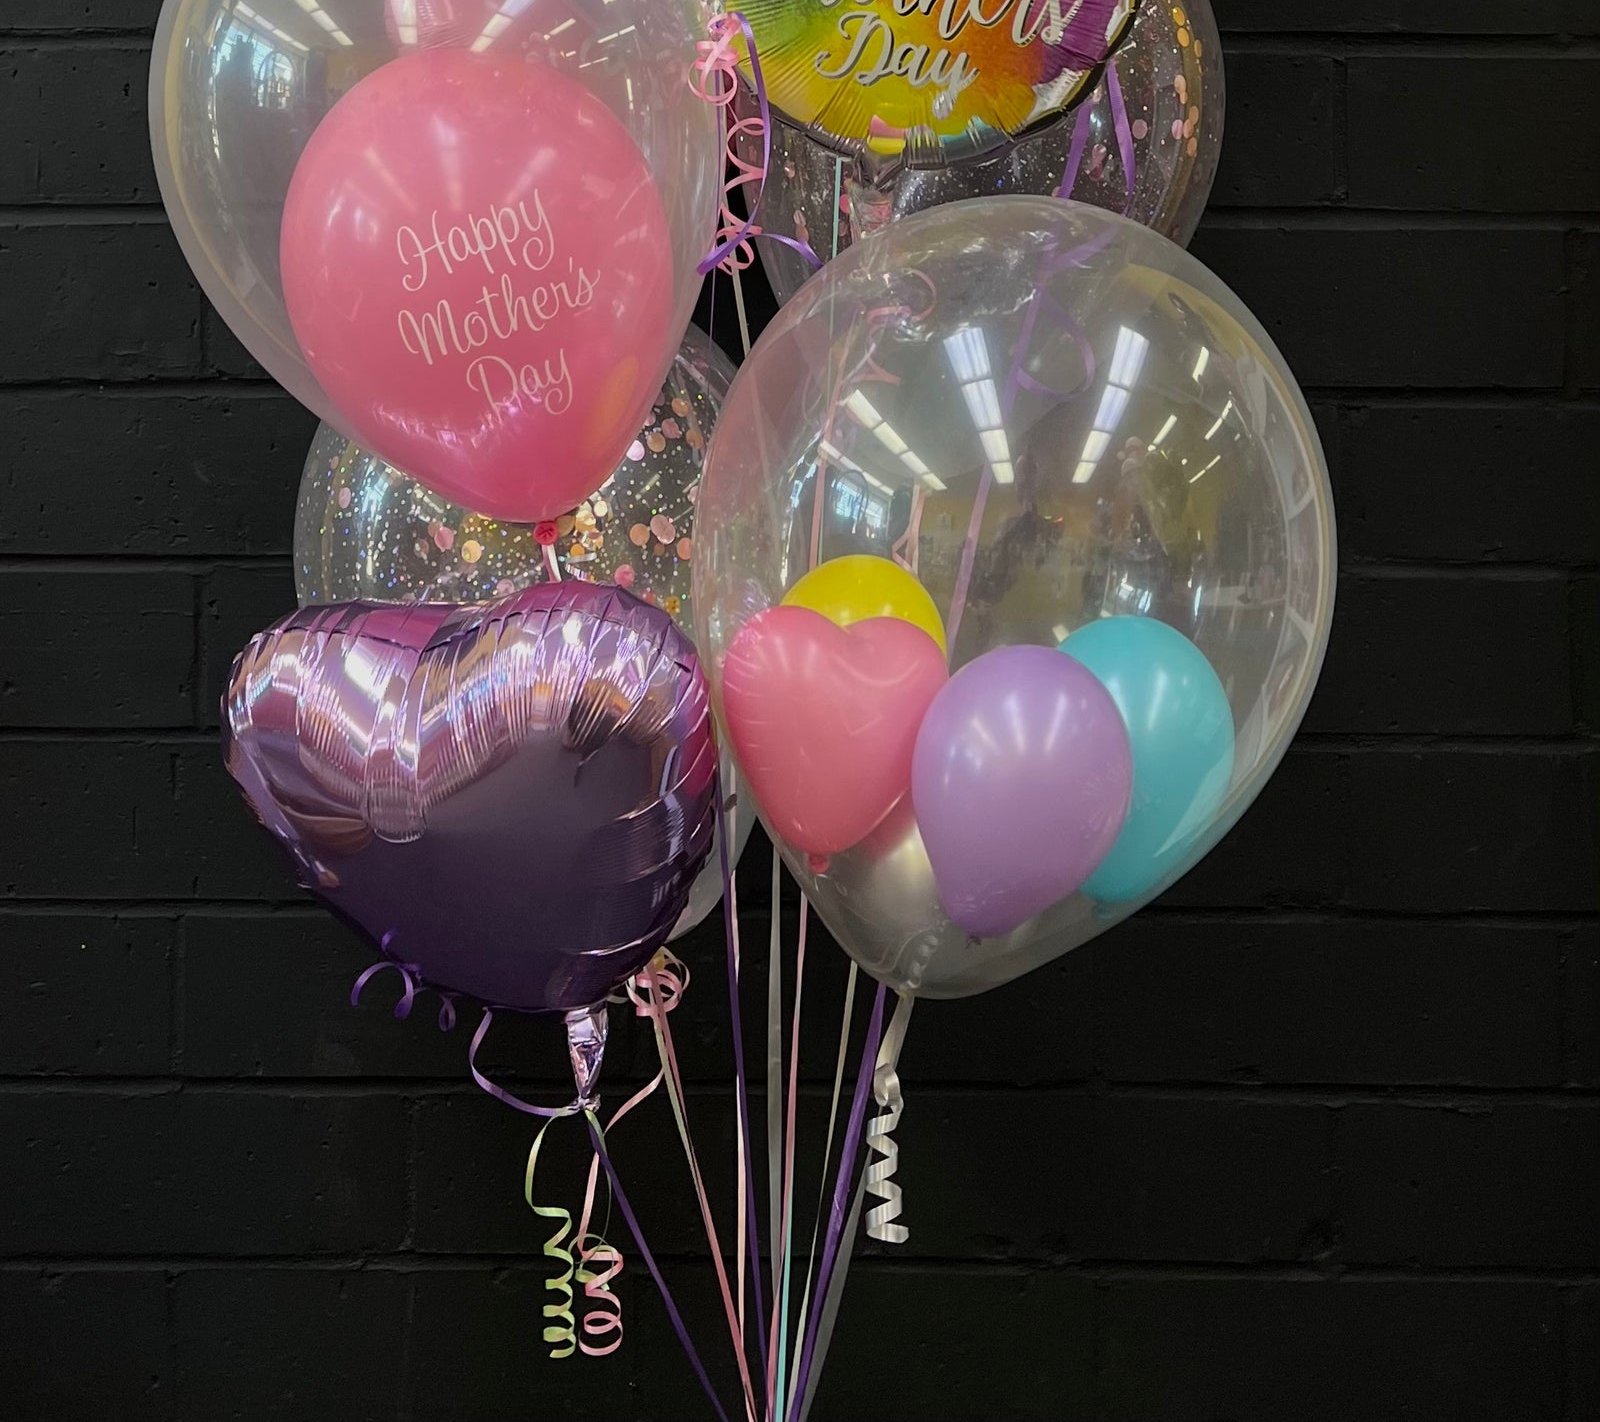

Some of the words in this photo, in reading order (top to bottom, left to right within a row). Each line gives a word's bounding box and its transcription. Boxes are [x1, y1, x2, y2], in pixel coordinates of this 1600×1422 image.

[814, 10, 979, 120] Day
[396, 188, 554, 292] Happy
[397, 257, 601, 365] Mother's
[466, 348, 573, 426] Day
